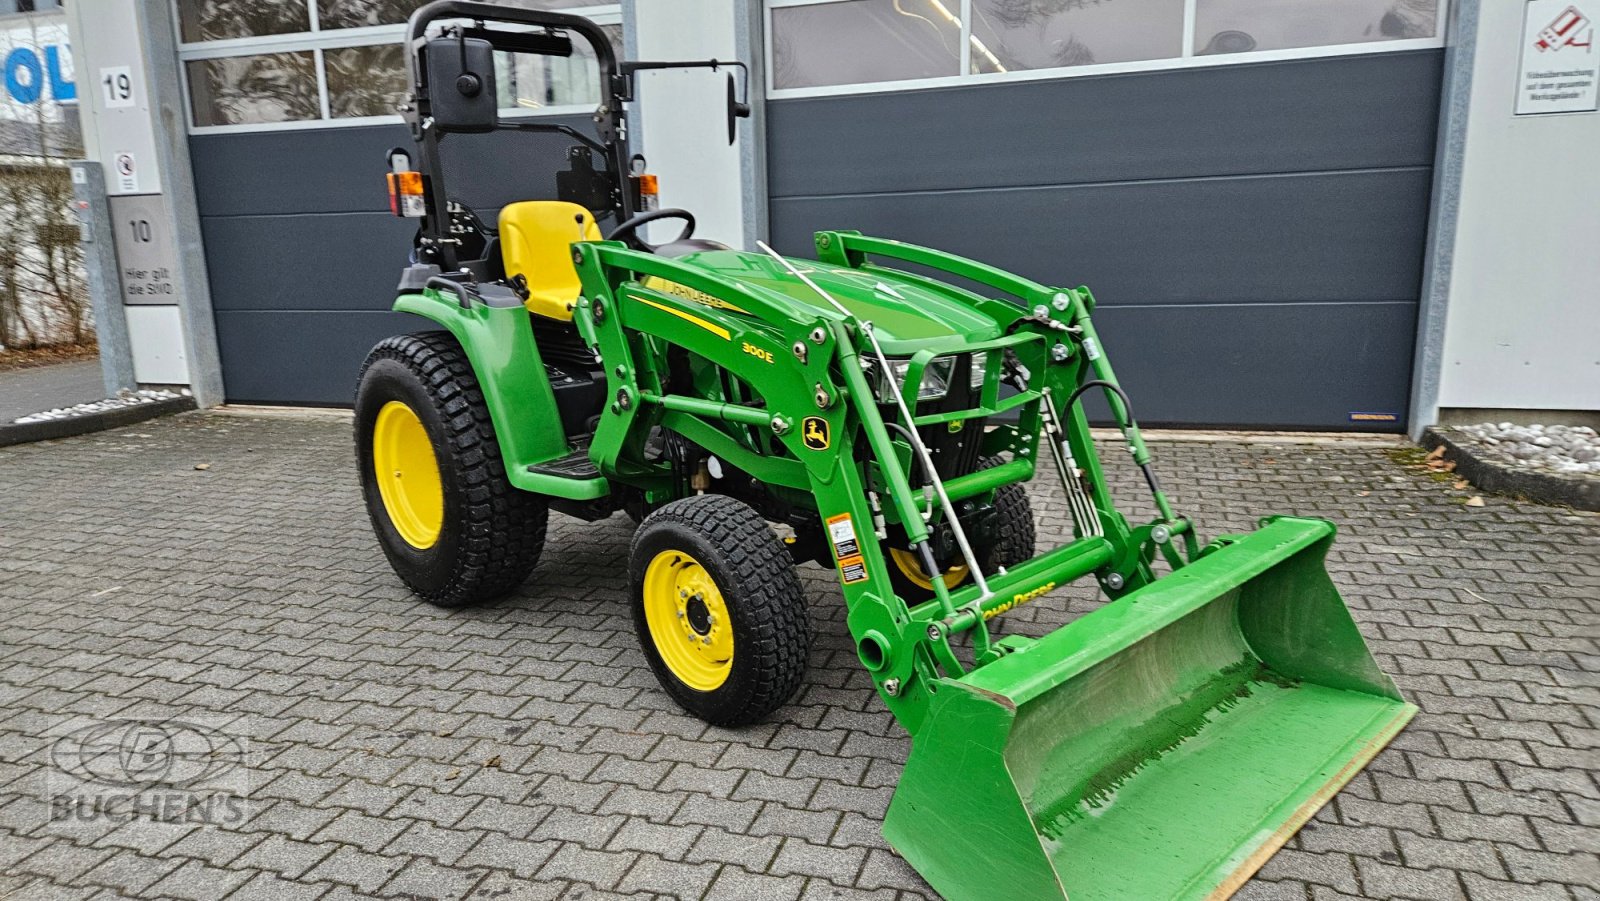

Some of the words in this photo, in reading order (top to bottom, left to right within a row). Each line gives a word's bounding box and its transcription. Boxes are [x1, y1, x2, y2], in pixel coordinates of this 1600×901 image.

[0, 44, 77, 104] OL
[103, 73, 132, 100] 19
[129, 219, 152, 243] 10
[125, 268, 149, 279] Hier
[151, 267, 170, 282] gilt
[128, 283, 144, 295] die
[670, 283, 692, 300] JOHN
[742, 341, 775, 364] 300E
[982, 600, 1013, 621] OHN
